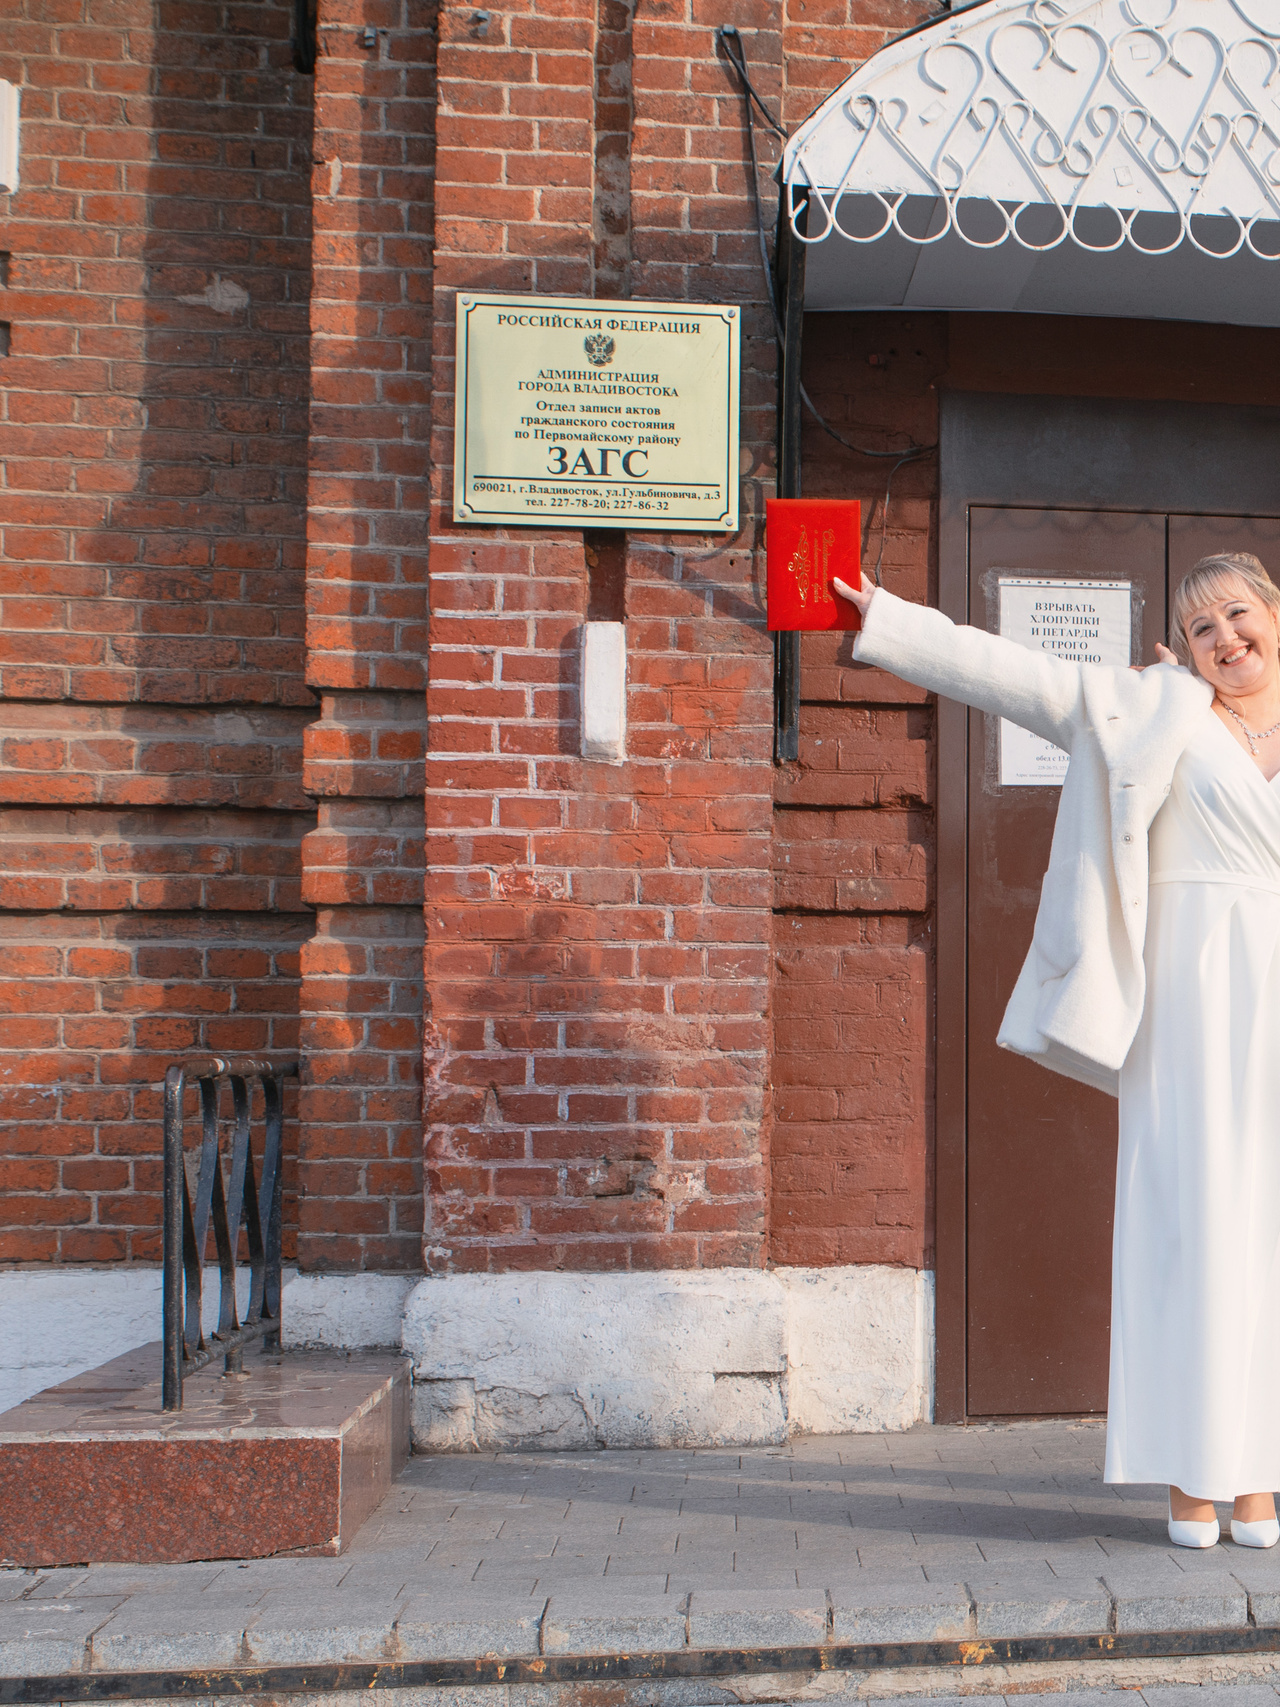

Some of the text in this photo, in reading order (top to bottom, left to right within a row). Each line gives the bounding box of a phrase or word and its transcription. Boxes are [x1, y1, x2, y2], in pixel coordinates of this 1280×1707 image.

[498, 314, 701, 334] РОССИЙСКАЯ ФЕДЕРАЦИЯ
[537, 370, 659, 383] АДМИНИСТРАЦИЯ
[518, 382, 679, 397] ГОРОДА ВЛАДИВОСТОКА
[536, 401, 661, 415] Отдел записи актов
[521, 416, 676, 430] гражданского состояния
[515, 429, 681, 446] по Первомайскому району
[547, 447, 649, 477] ЗАГС
[473, 483, 516, 494] 690021,
[704, 491, 721, 501] д.3
[526, 499, 669, 511] тел. 227-78-20; 227-86-32
[1035, 602, 1096, 613] ВЗРЫВАТЬ
[1030, 615, 1100, 626] ХЛОПУШКИ
[1031, 628, 1100, 639] И ПЕТАРДЫ
[1042, 640, 1088, 650] СТРОГО
